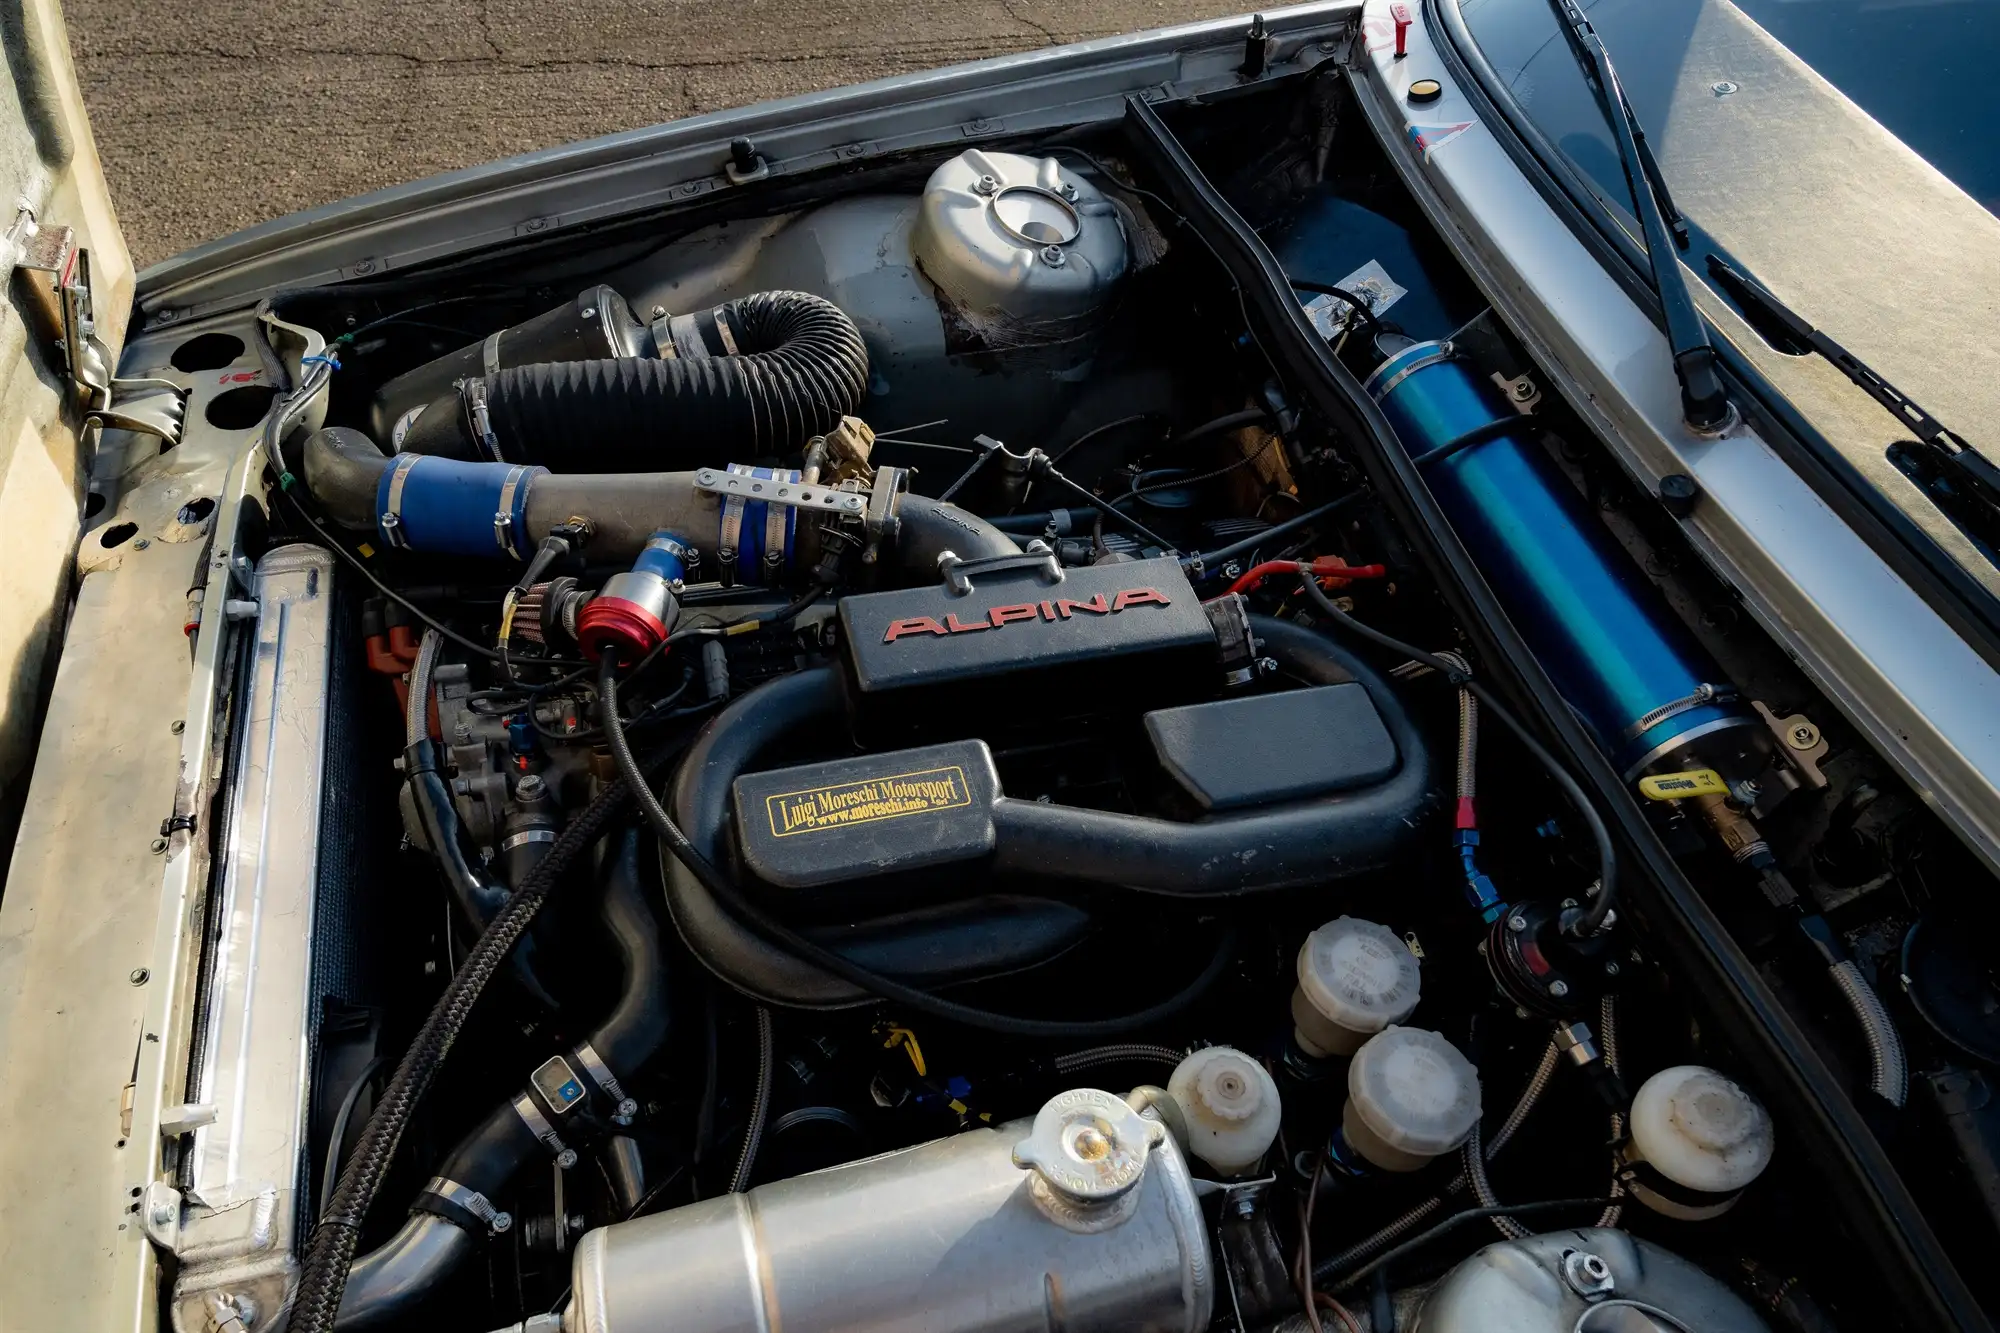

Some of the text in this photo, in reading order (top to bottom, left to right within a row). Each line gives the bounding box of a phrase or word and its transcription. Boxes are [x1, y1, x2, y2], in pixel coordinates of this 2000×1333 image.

[930, 507, 983, 536] ALPINA
[883, 587, 1171, 642] ALPINA
[780, 776, 958, 831] Luigi Moreschi Motorsport
[816, 798, 929, 826] www.moreschi.info
[1049, 1092, 1114, 1113] TIGHTEN
